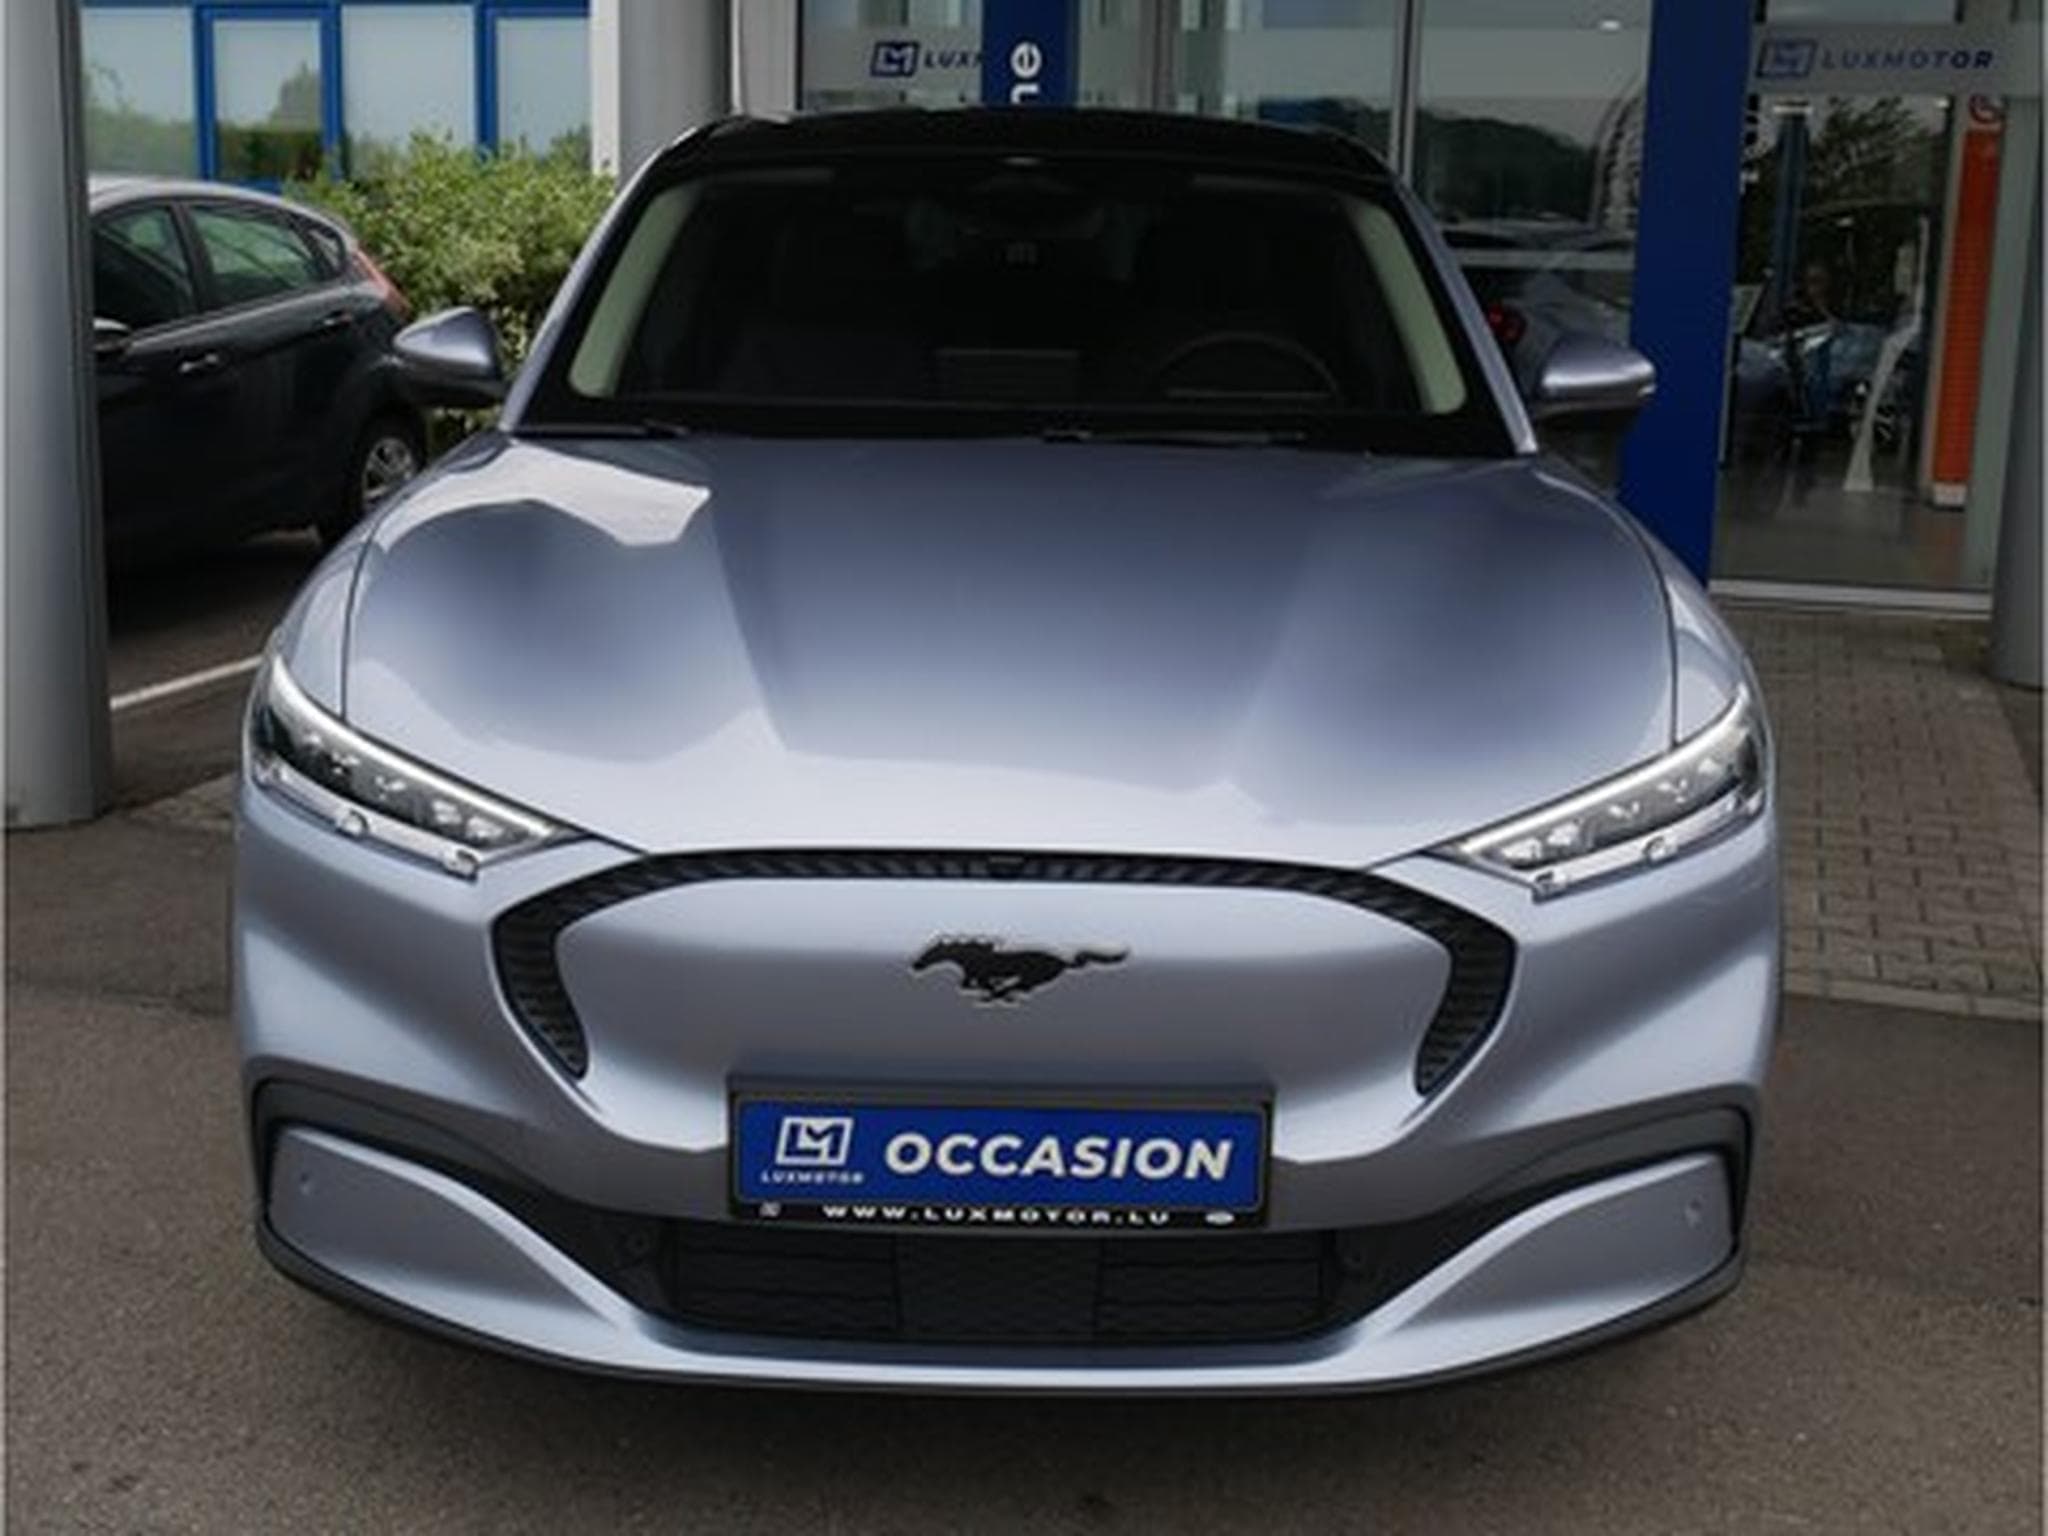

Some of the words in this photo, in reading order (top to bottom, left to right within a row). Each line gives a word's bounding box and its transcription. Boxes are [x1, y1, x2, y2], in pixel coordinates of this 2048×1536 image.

[924, 51, 982, 68] LUX
[1820, 49, 1995, 70] LUXMOTOR
[885, 1133, 1234, 1181] OCCASION
[760, 1170, 865, 1184] LUXMOTOR
